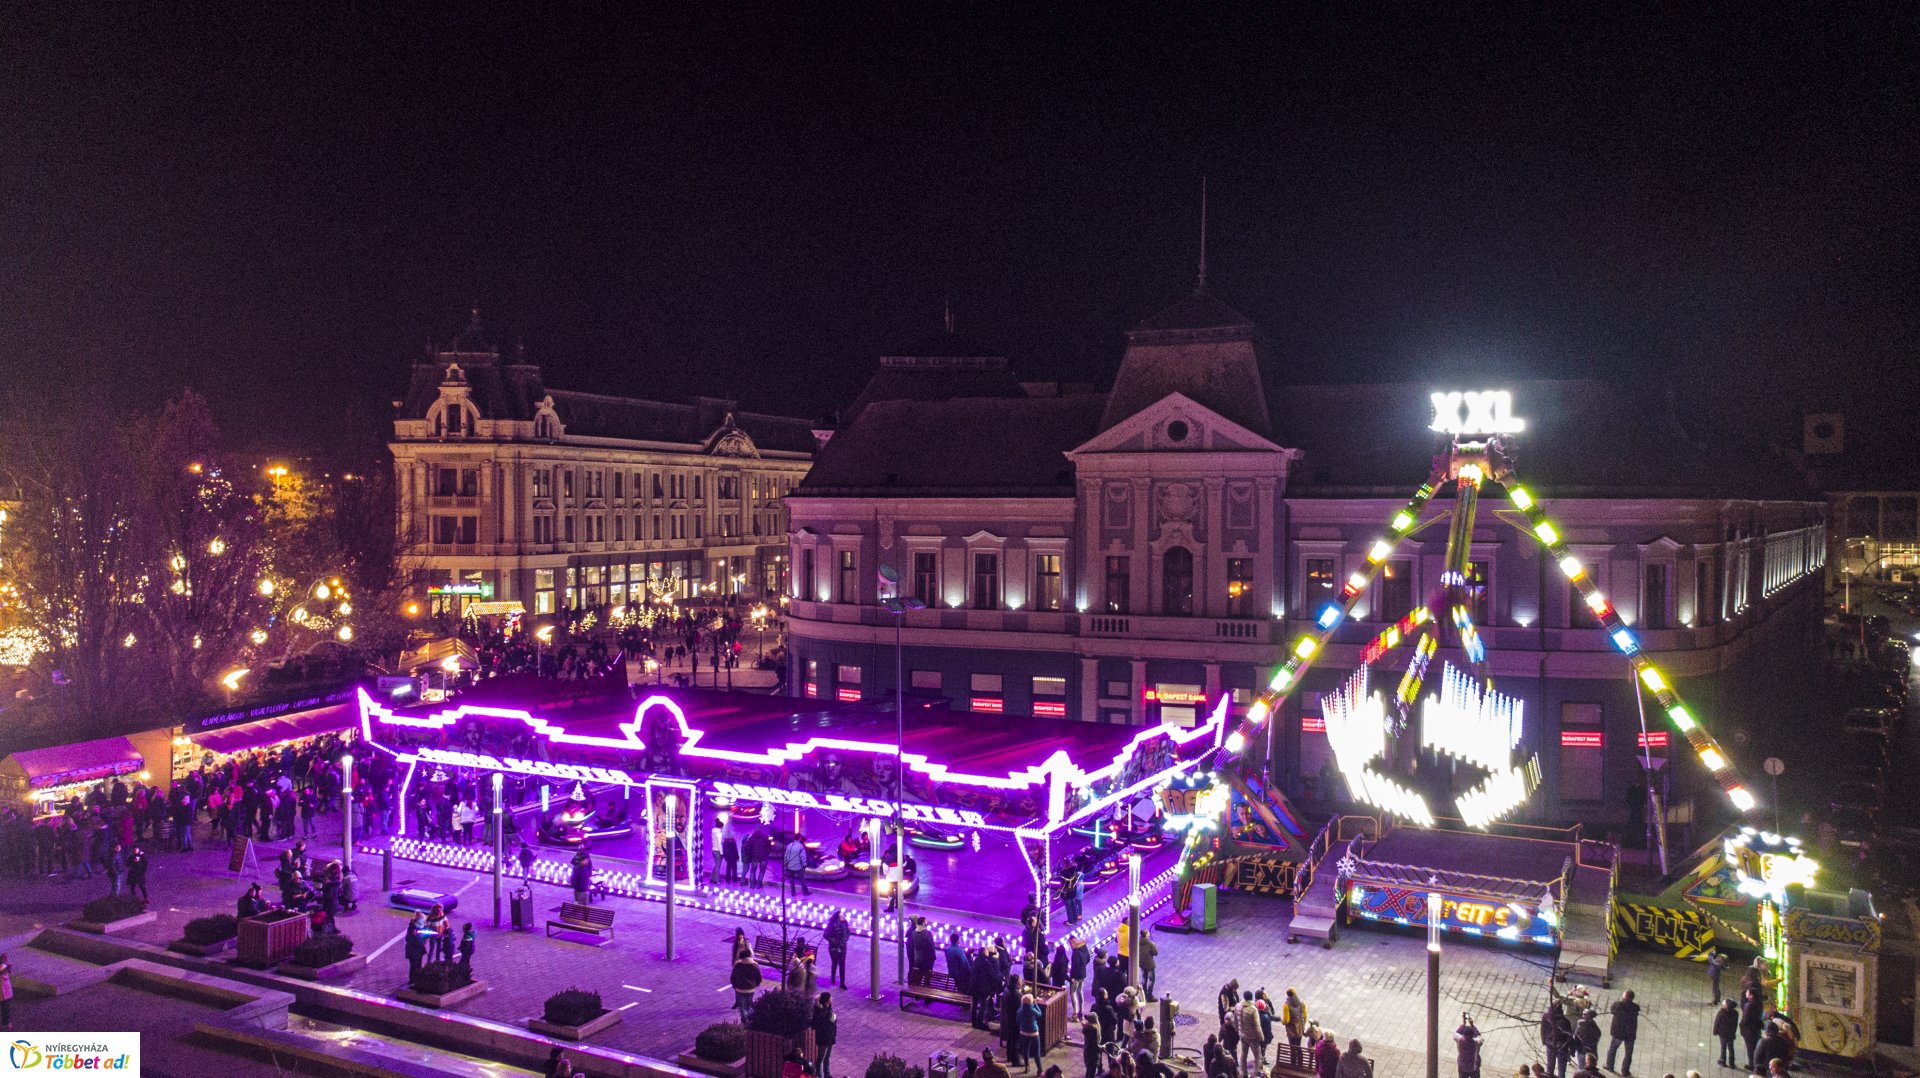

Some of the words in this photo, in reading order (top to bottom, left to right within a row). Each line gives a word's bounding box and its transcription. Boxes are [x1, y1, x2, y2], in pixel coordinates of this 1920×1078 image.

[1430, 390, 1525, 434] XXL
[1156, 692, 1187, 701] BUDAPEST
[1188, 694, 1206, 702] BANK
